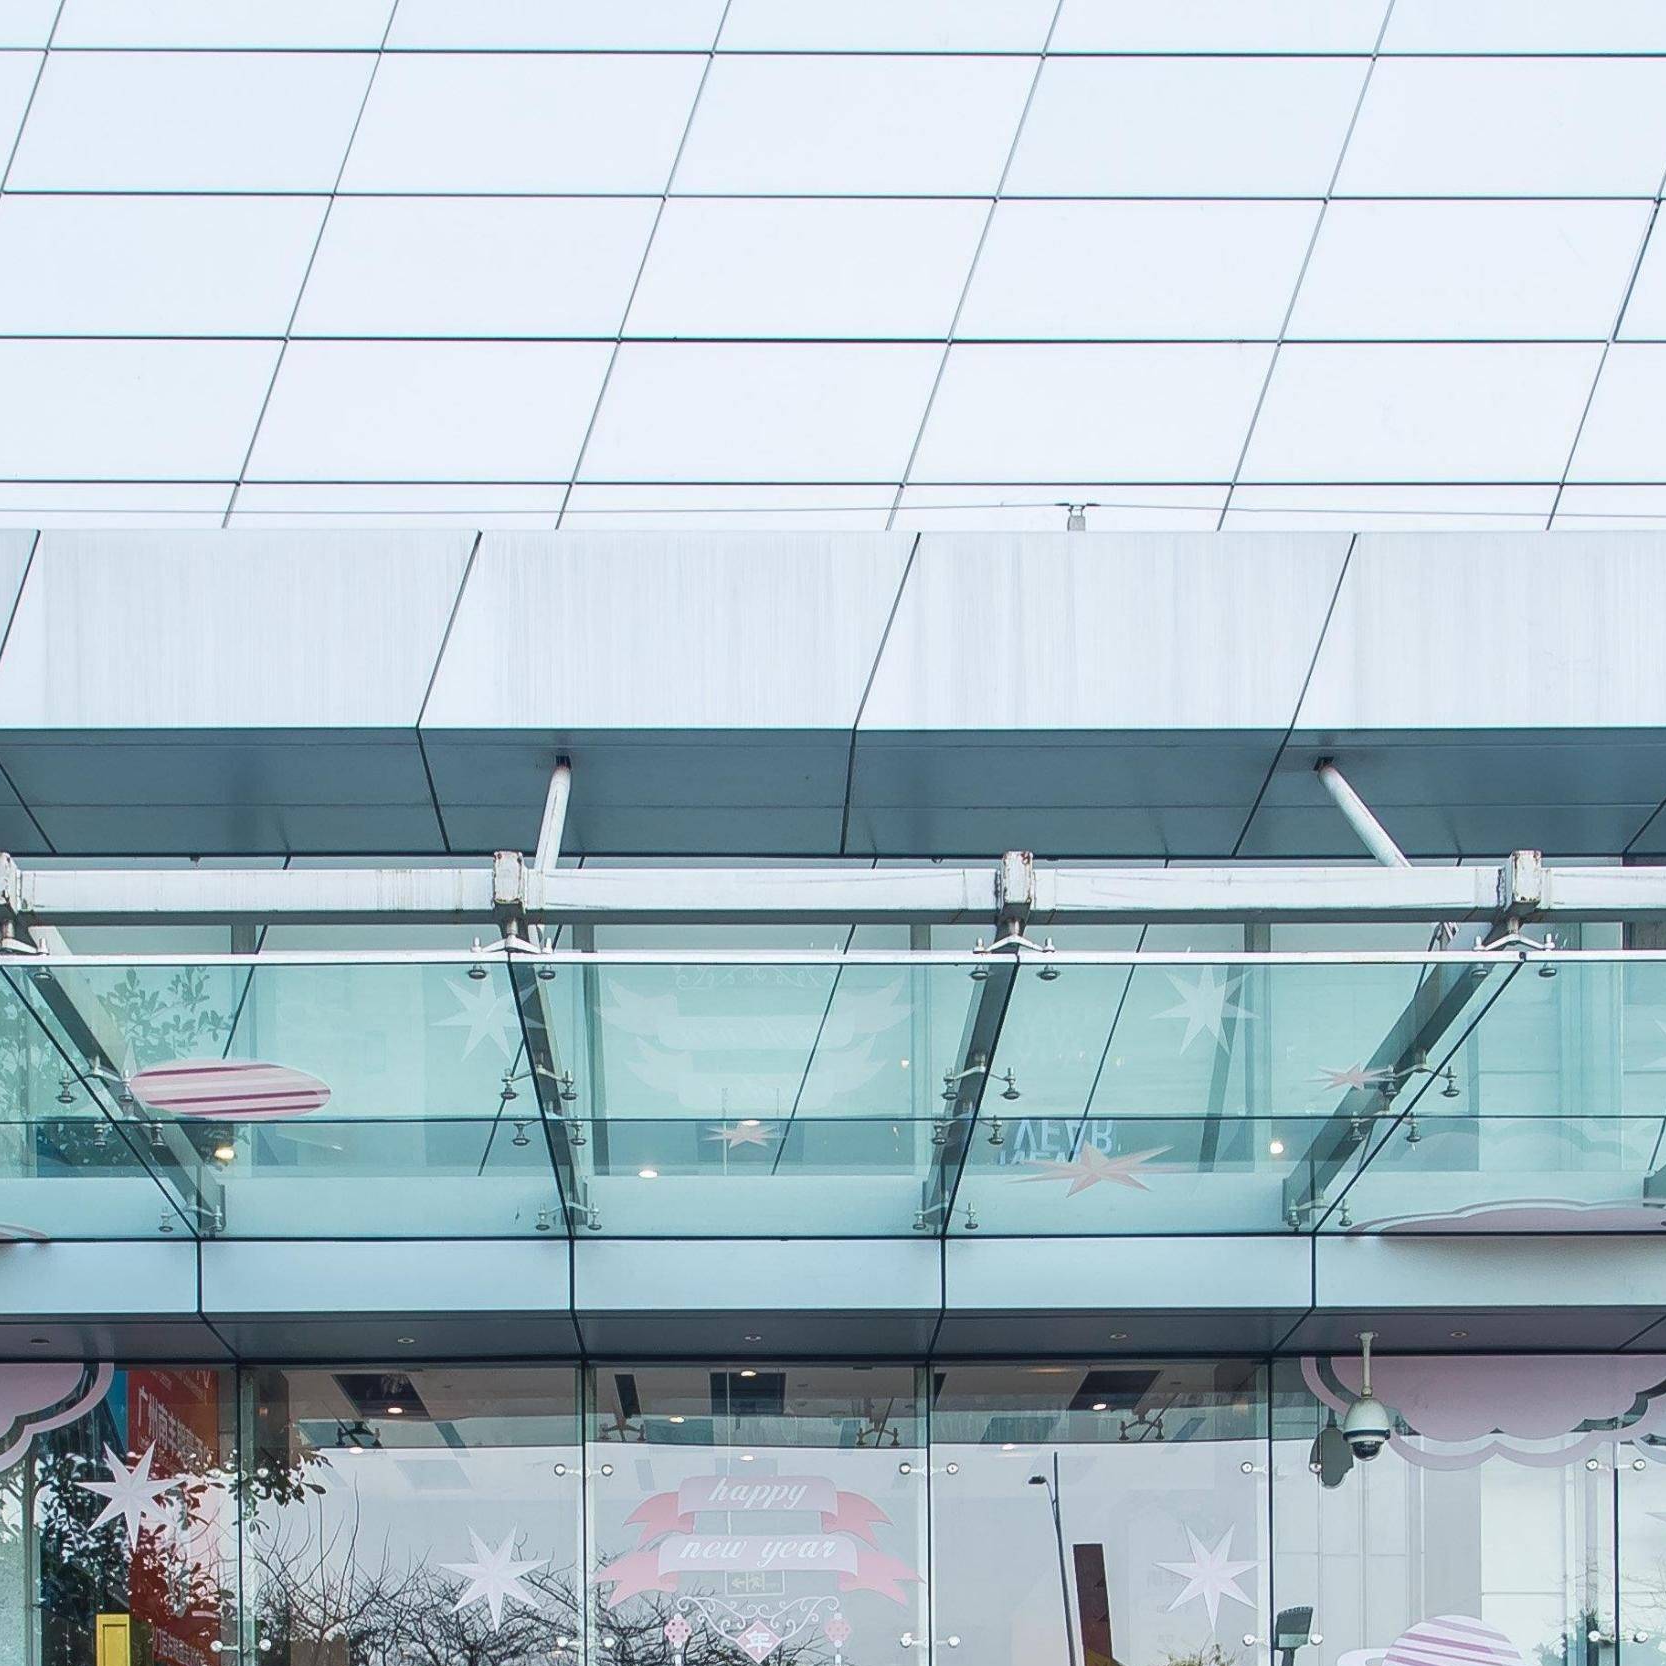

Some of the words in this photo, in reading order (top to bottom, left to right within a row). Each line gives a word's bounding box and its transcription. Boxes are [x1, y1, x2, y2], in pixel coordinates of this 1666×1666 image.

[708, 1477, 808, 1509] happy
[679, 1542, 748, 1559] new
[757, 1540, 838, 1568] year
[746, 1631, 771, 1652] 年
